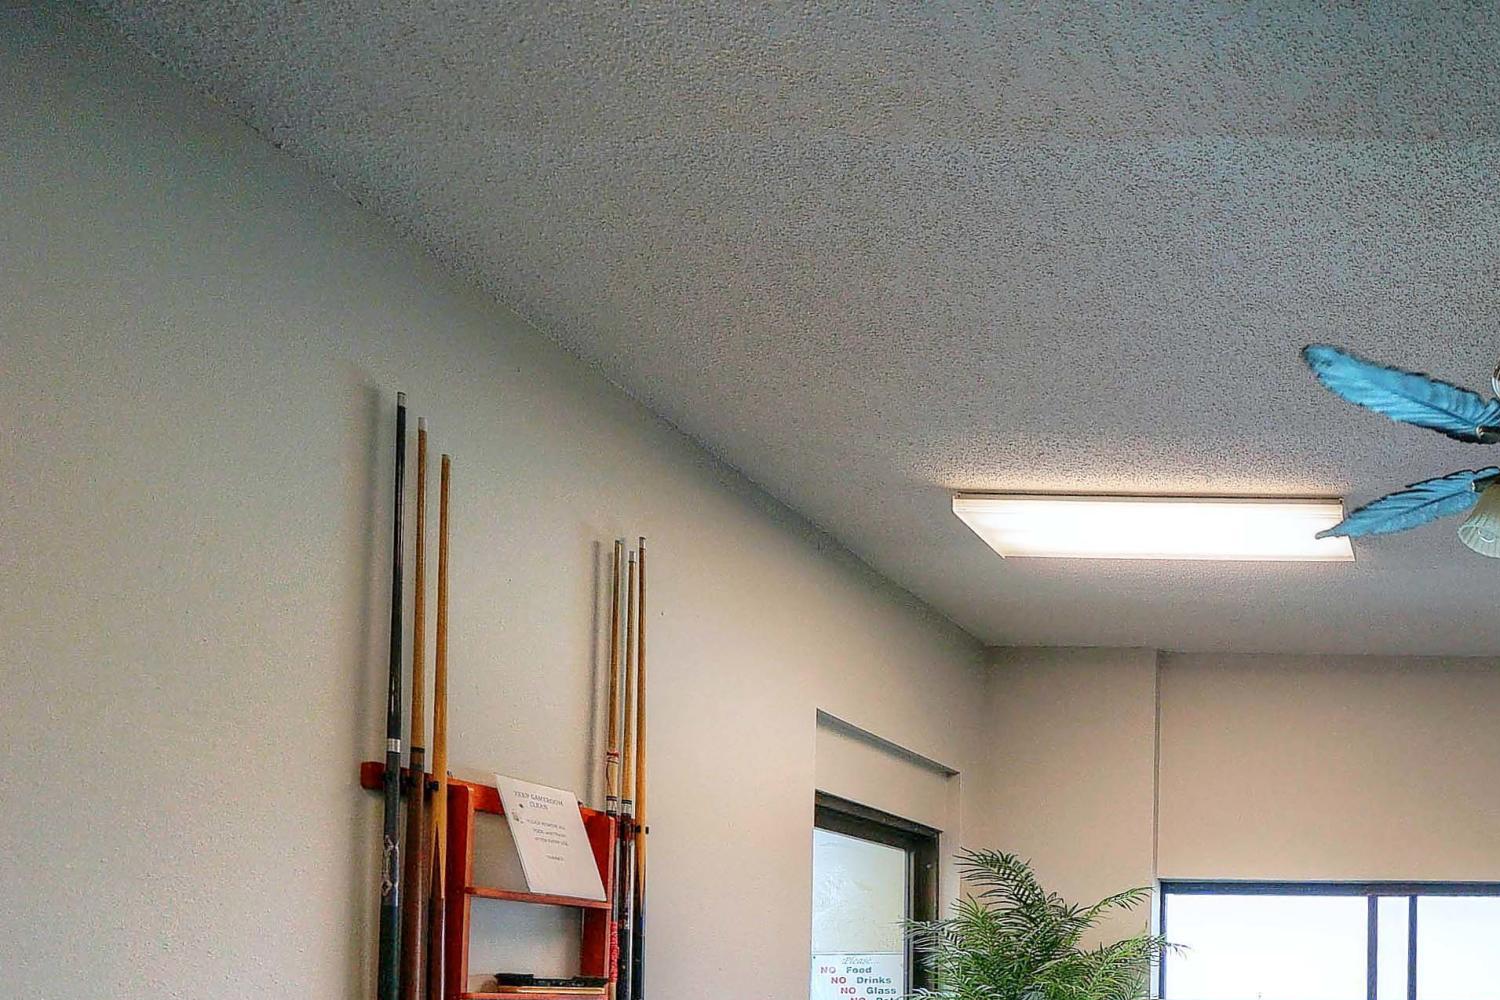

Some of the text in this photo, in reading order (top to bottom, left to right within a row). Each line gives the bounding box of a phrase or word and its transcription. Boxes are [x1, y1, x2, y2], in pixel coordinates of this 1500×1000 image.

[820, 966, 872, 974] NO Food
[831, 976, 892, 984] NO Drinks
